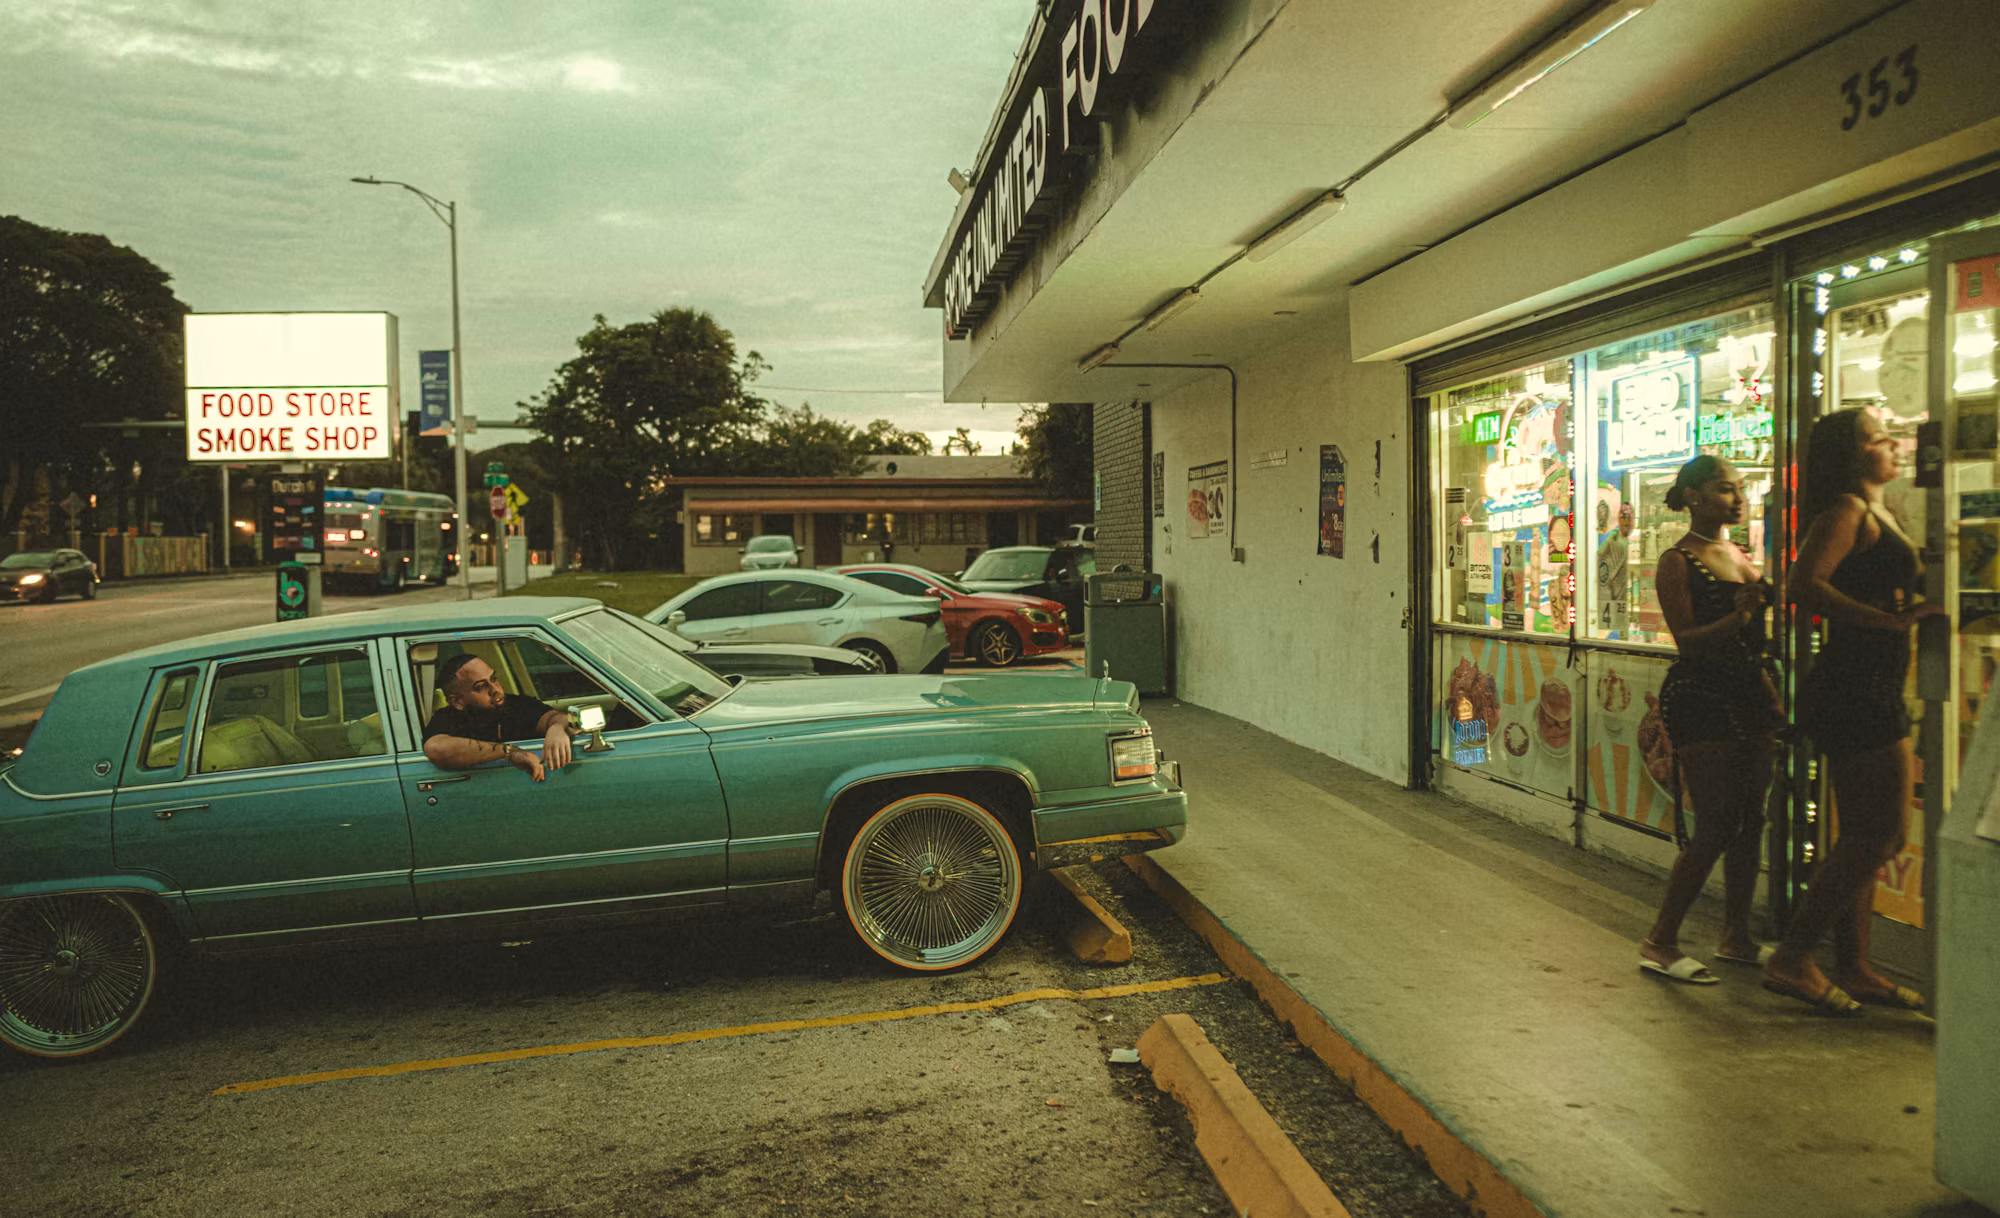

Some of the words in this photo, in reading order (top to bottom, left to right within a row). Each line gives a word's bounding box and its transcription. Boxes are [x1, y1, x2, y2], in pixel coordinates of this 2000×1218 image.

[1841, 44, 1919, 132] 353
[945, 230, 972, 336] SMOKE
[973, 86, 1047, 293] UNLIMITED
[202, 393, 273, 418] FOOD
[286, 392, 372, 417] STORE
[197, 427, 294, 452] SMOKE
[305, 426, 378, 451] SHOP
[1475, 415, 1500, 442] ATM
[272, 479, 304, 493] Dutch
[1322, 467, 1344, 482] Unlimited
[1449, 545, 1455, 567] 2
[1470, 563, 1492, 572] BITCOIN
[1504, 544, 1512, 567] 3
[1602, 602, 1611, 629] 4
[1451, 717, 1487, 748] Corona
